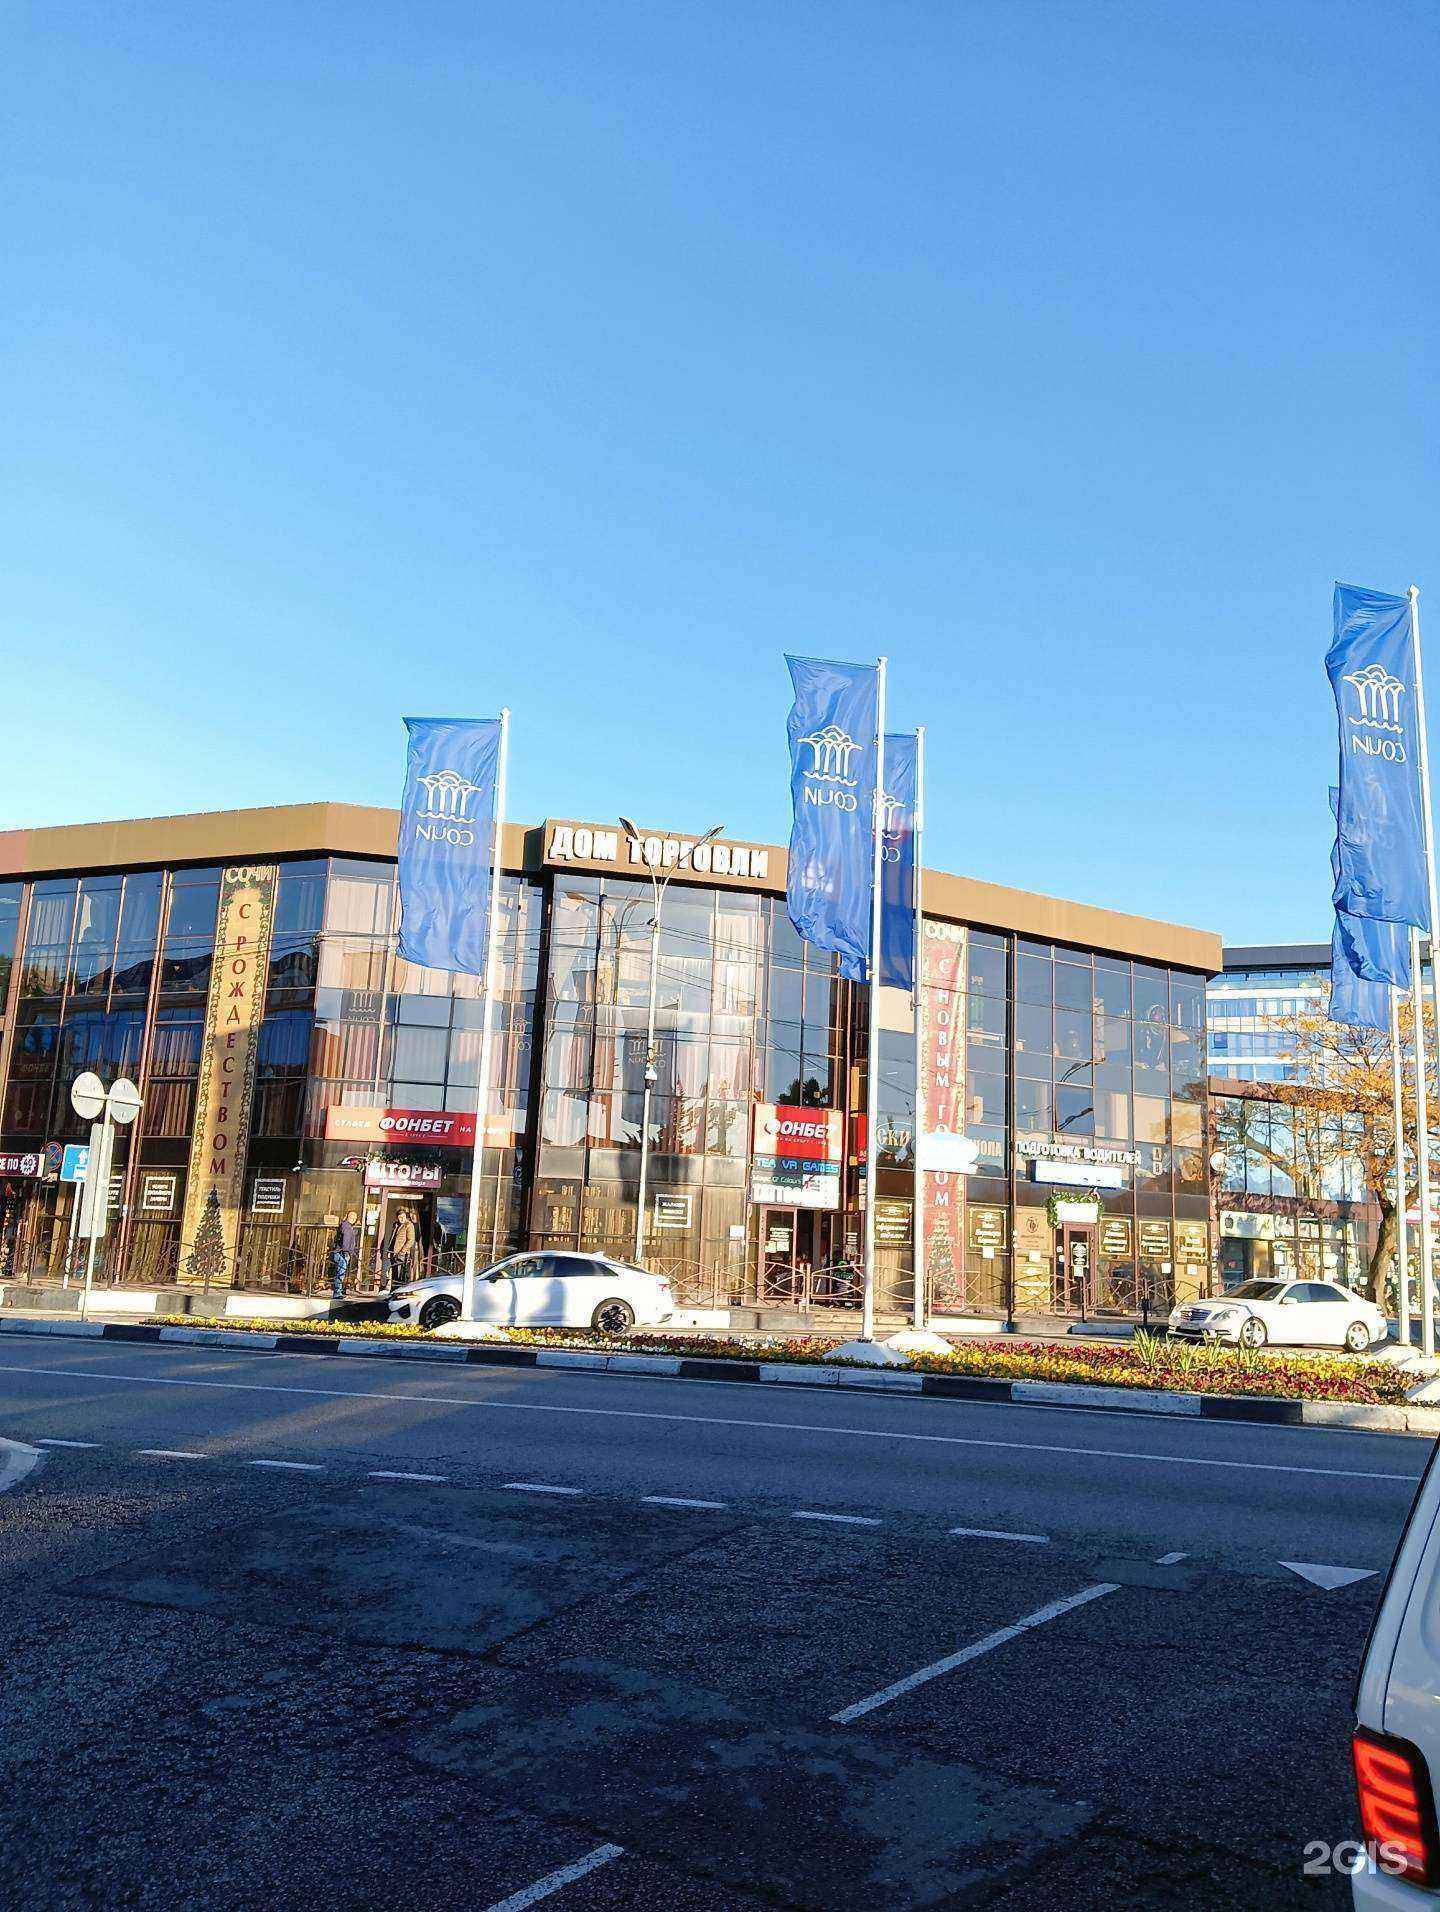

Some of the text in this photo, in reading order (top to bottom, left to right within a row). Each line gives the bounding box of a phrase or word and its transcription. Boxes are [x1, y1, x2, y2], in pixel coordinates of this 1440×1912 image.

[549, 825, 769, 879] ДОМ ТОРГОВЛИ
[209, 935, 246, 1174] РОЖДЕСТВОМ
[379, 1117, 454, 1134] ФОНБЕТ
[367, 1161, 440, 1181] ШТОРЫ
[802, 1161, 840, 1173] GAMES
[934, 1104, 950, 1207] ГООМ
